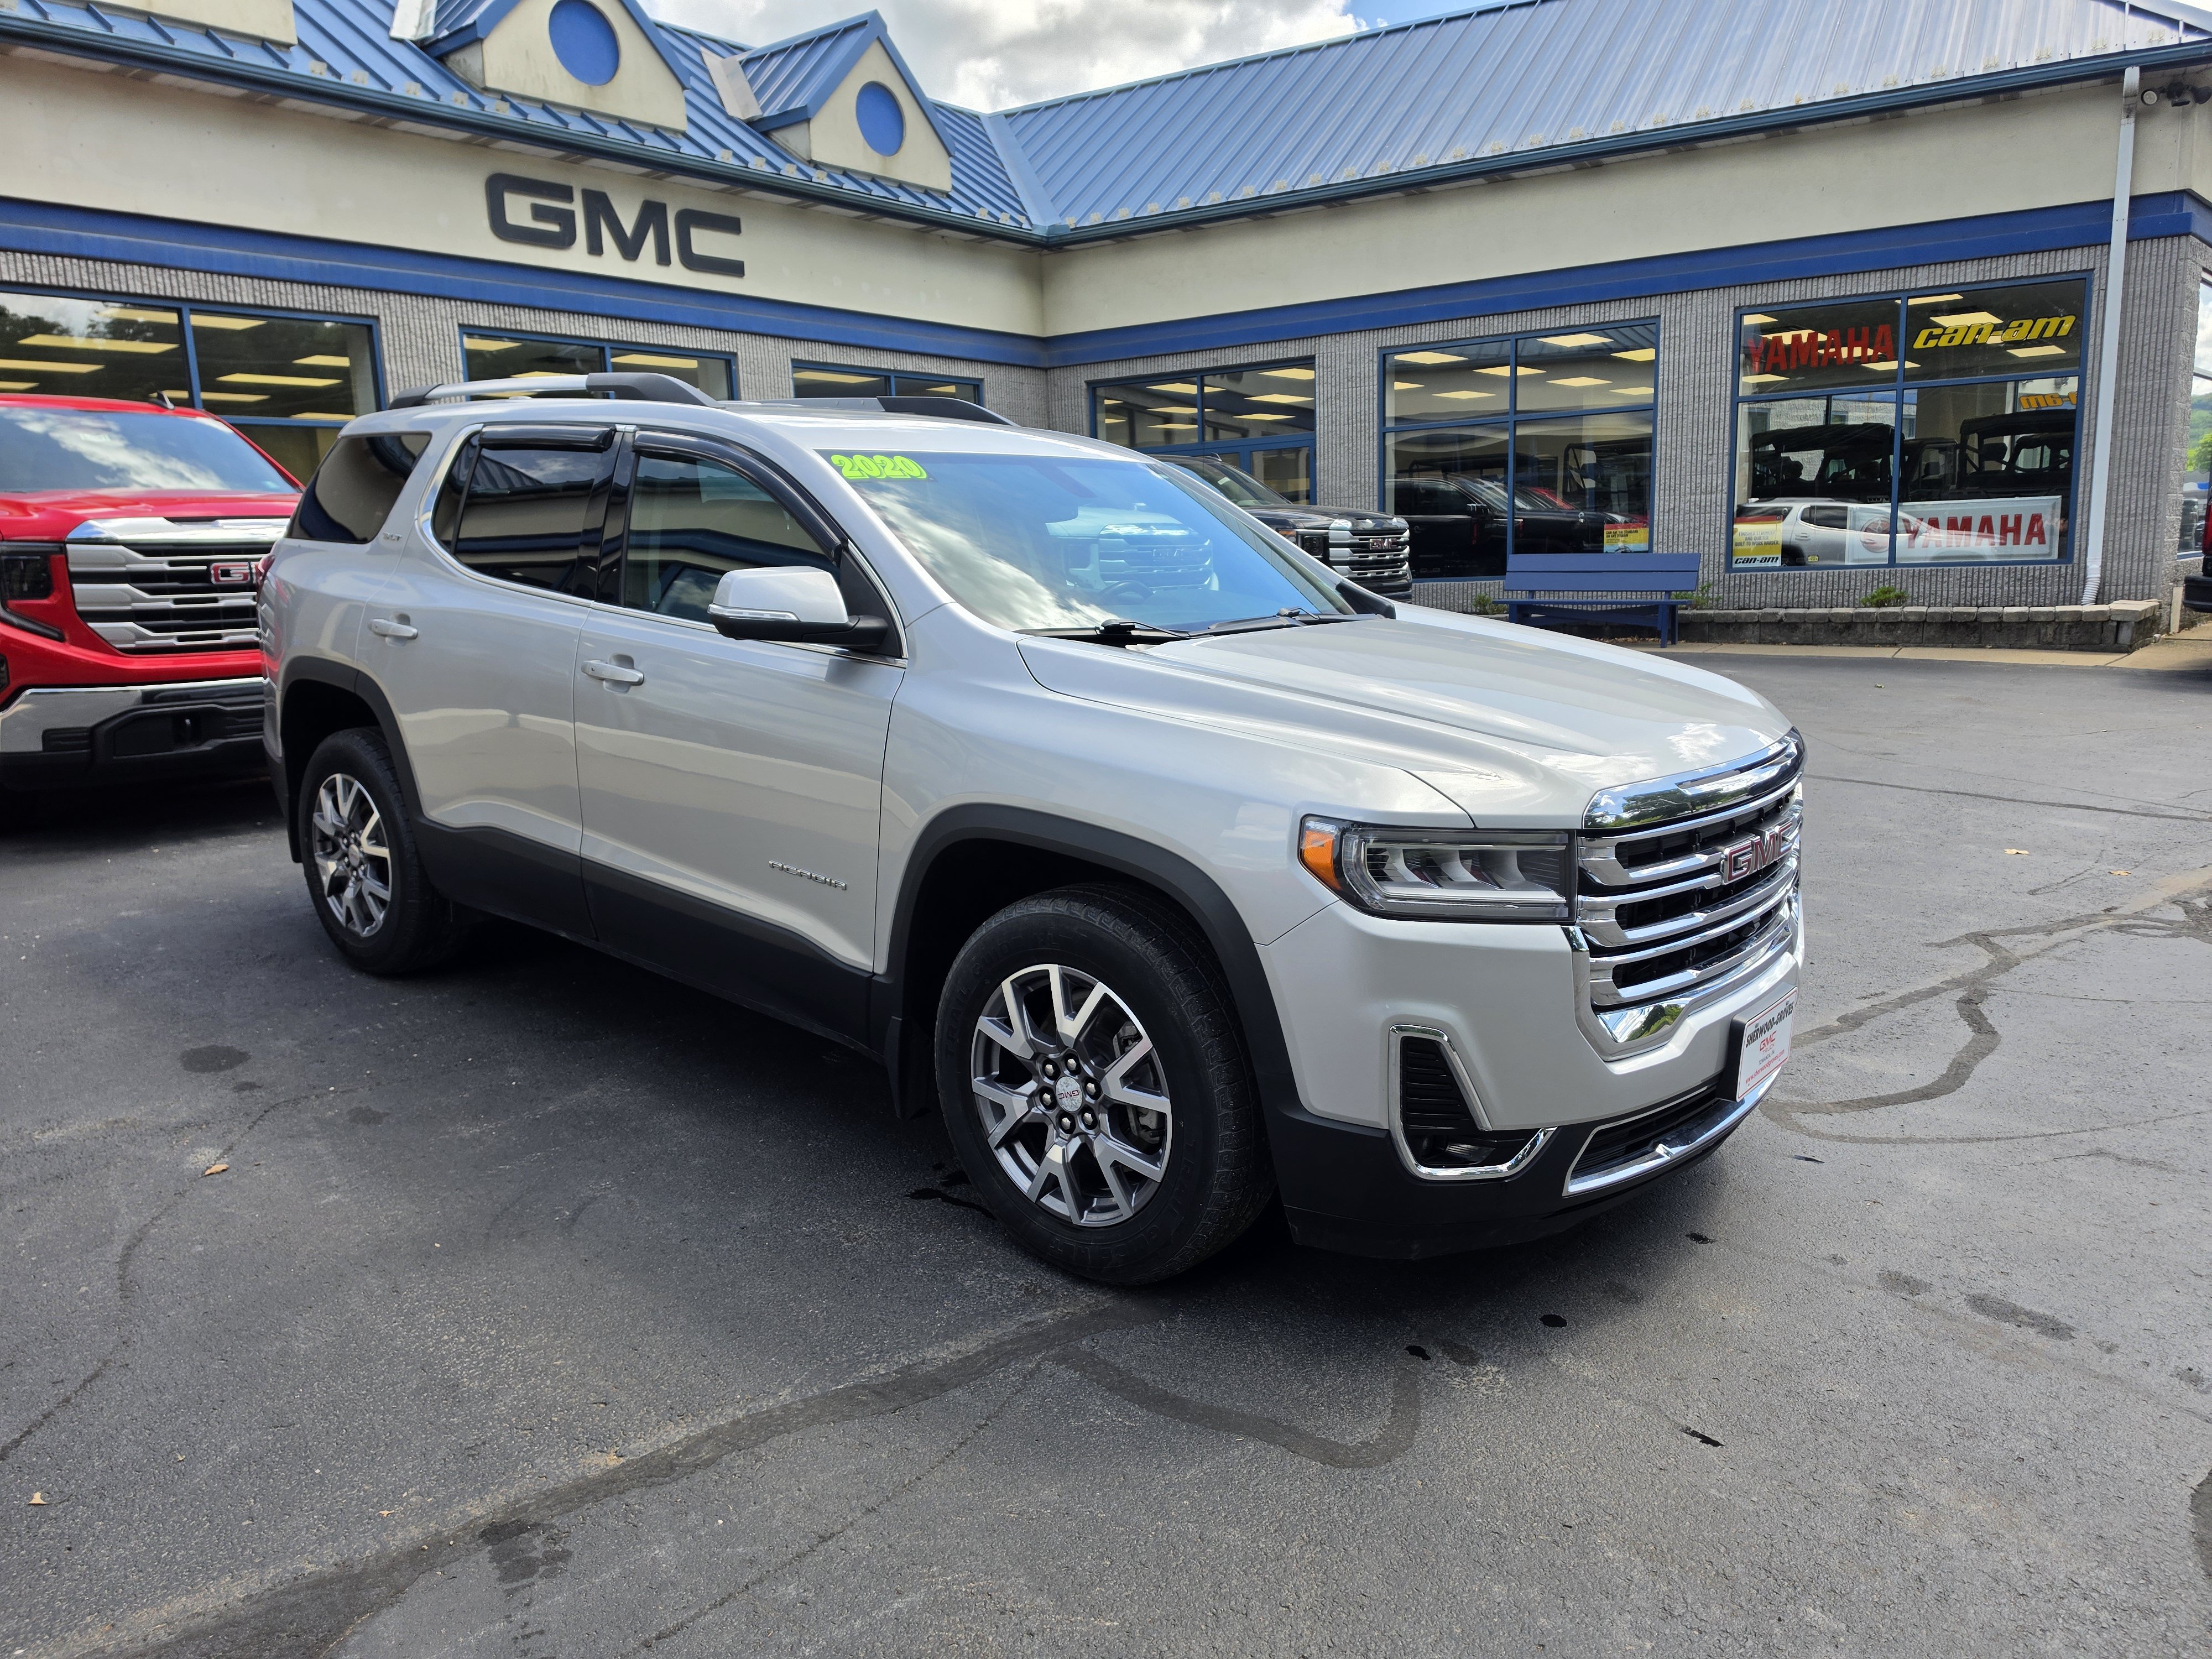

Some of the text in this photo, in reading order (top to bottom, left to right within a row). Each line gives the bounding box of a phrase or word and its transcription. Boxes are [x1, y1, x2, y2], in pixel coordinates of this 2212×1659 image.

[485, 172, 745, 278] GMC
[1746, 324, 1895, 373] YAMAHA
[1912, 314, 2077, 349] can-am
[831, 454, 927, 480] 2020
[1902, 513, 2047, 549] YAMAHA
[1720, 821, 1793, 885] GMC
[769, 860, 847, 890] ACADIA
[1745, 1000, 1794, 1048] SHERWOOD-GROVES
[1759, 1030, 1777, 1052] GMC
[1745, 1048, 1785, 1085] www.sherwoodgroves.com
[1057, 1089, 1079, 1099] GMC
